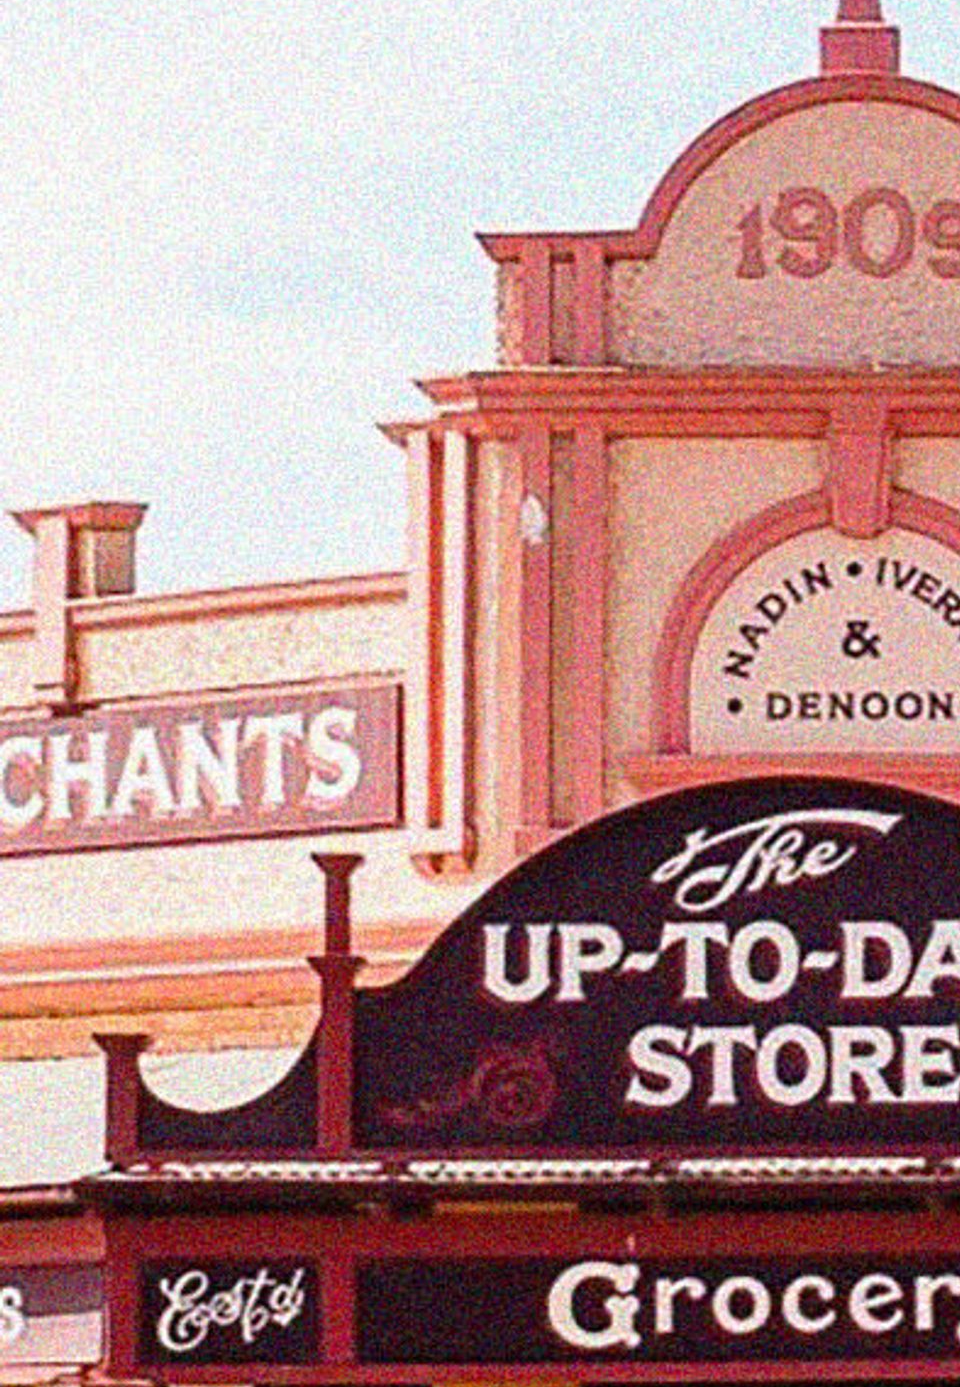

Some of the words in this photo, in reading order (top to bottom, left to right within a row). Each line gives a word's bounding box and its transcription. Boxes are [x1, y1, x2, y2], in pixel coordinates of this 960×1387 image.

[723, 559, 834, 680] NADIN
[841, 619, 881, 659] &
[766, 691, 955, 721] DENOON
[0, 706, 362, 823] CHANTS
[650, 809, 903, 913] The
